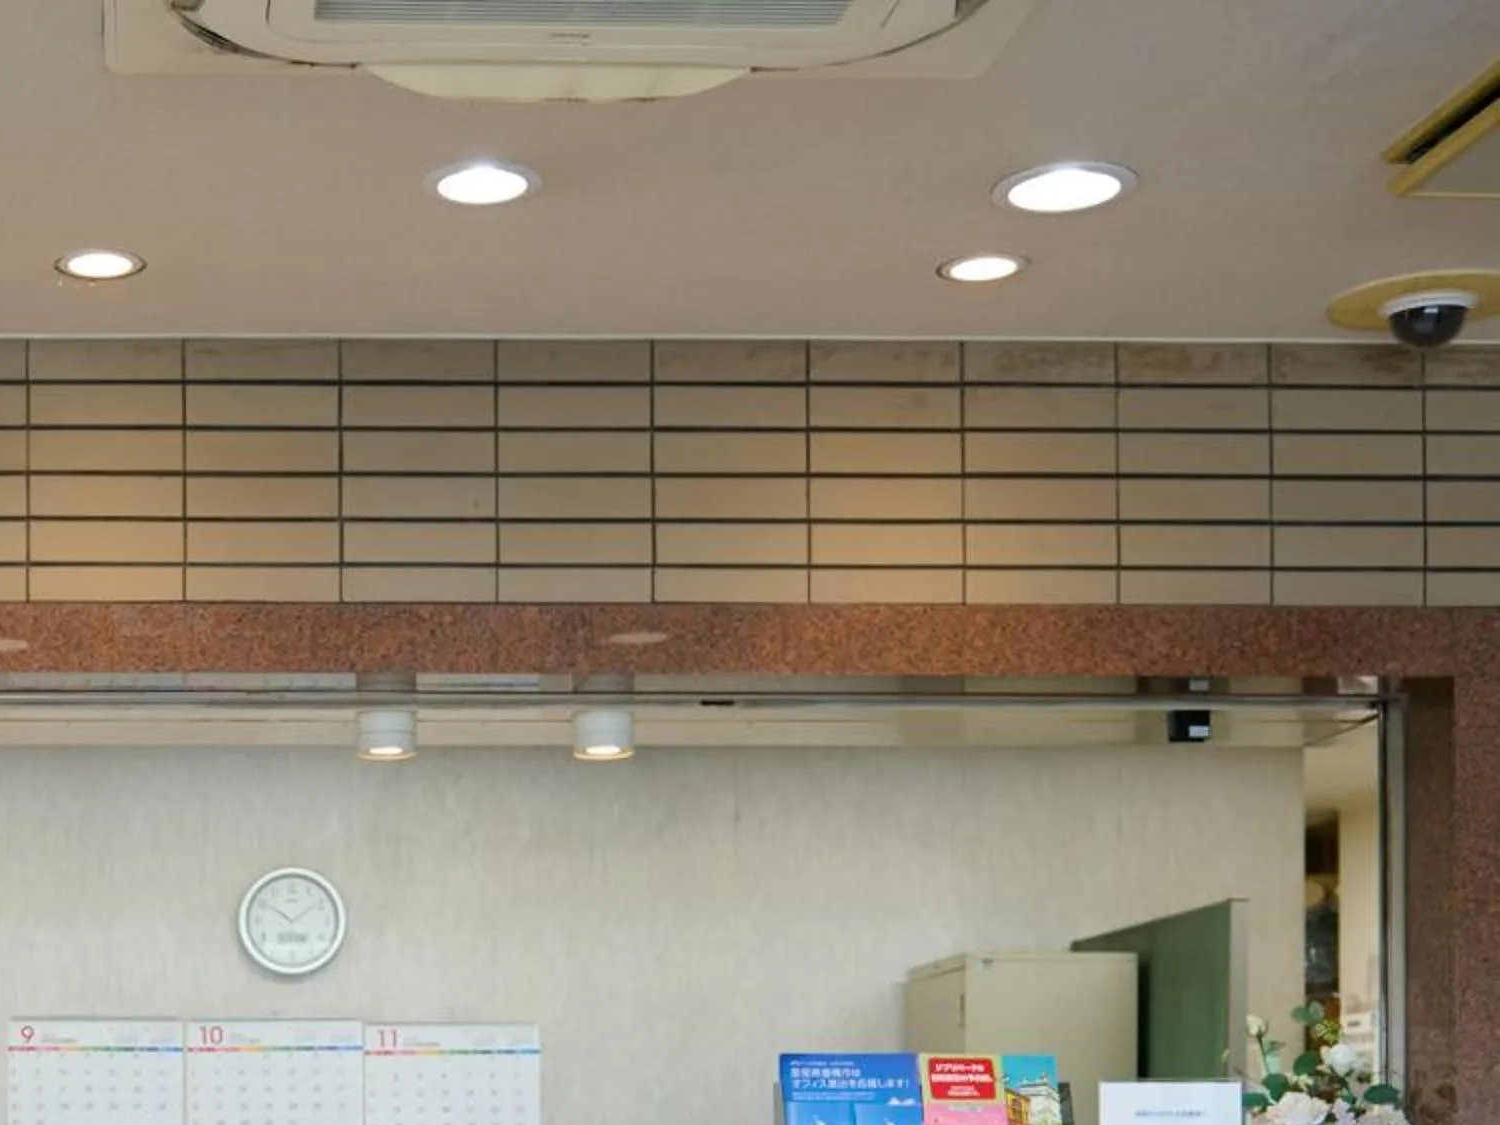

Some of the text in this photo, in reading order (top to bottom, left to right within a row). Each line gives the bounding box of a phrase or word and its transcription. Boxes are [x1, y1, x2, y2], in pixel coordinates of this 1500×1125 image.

[21, 1025, 35, 1043] 9
[200, 1026, 225, 1045] 10
[377, 1029, 398, 1048] 11
